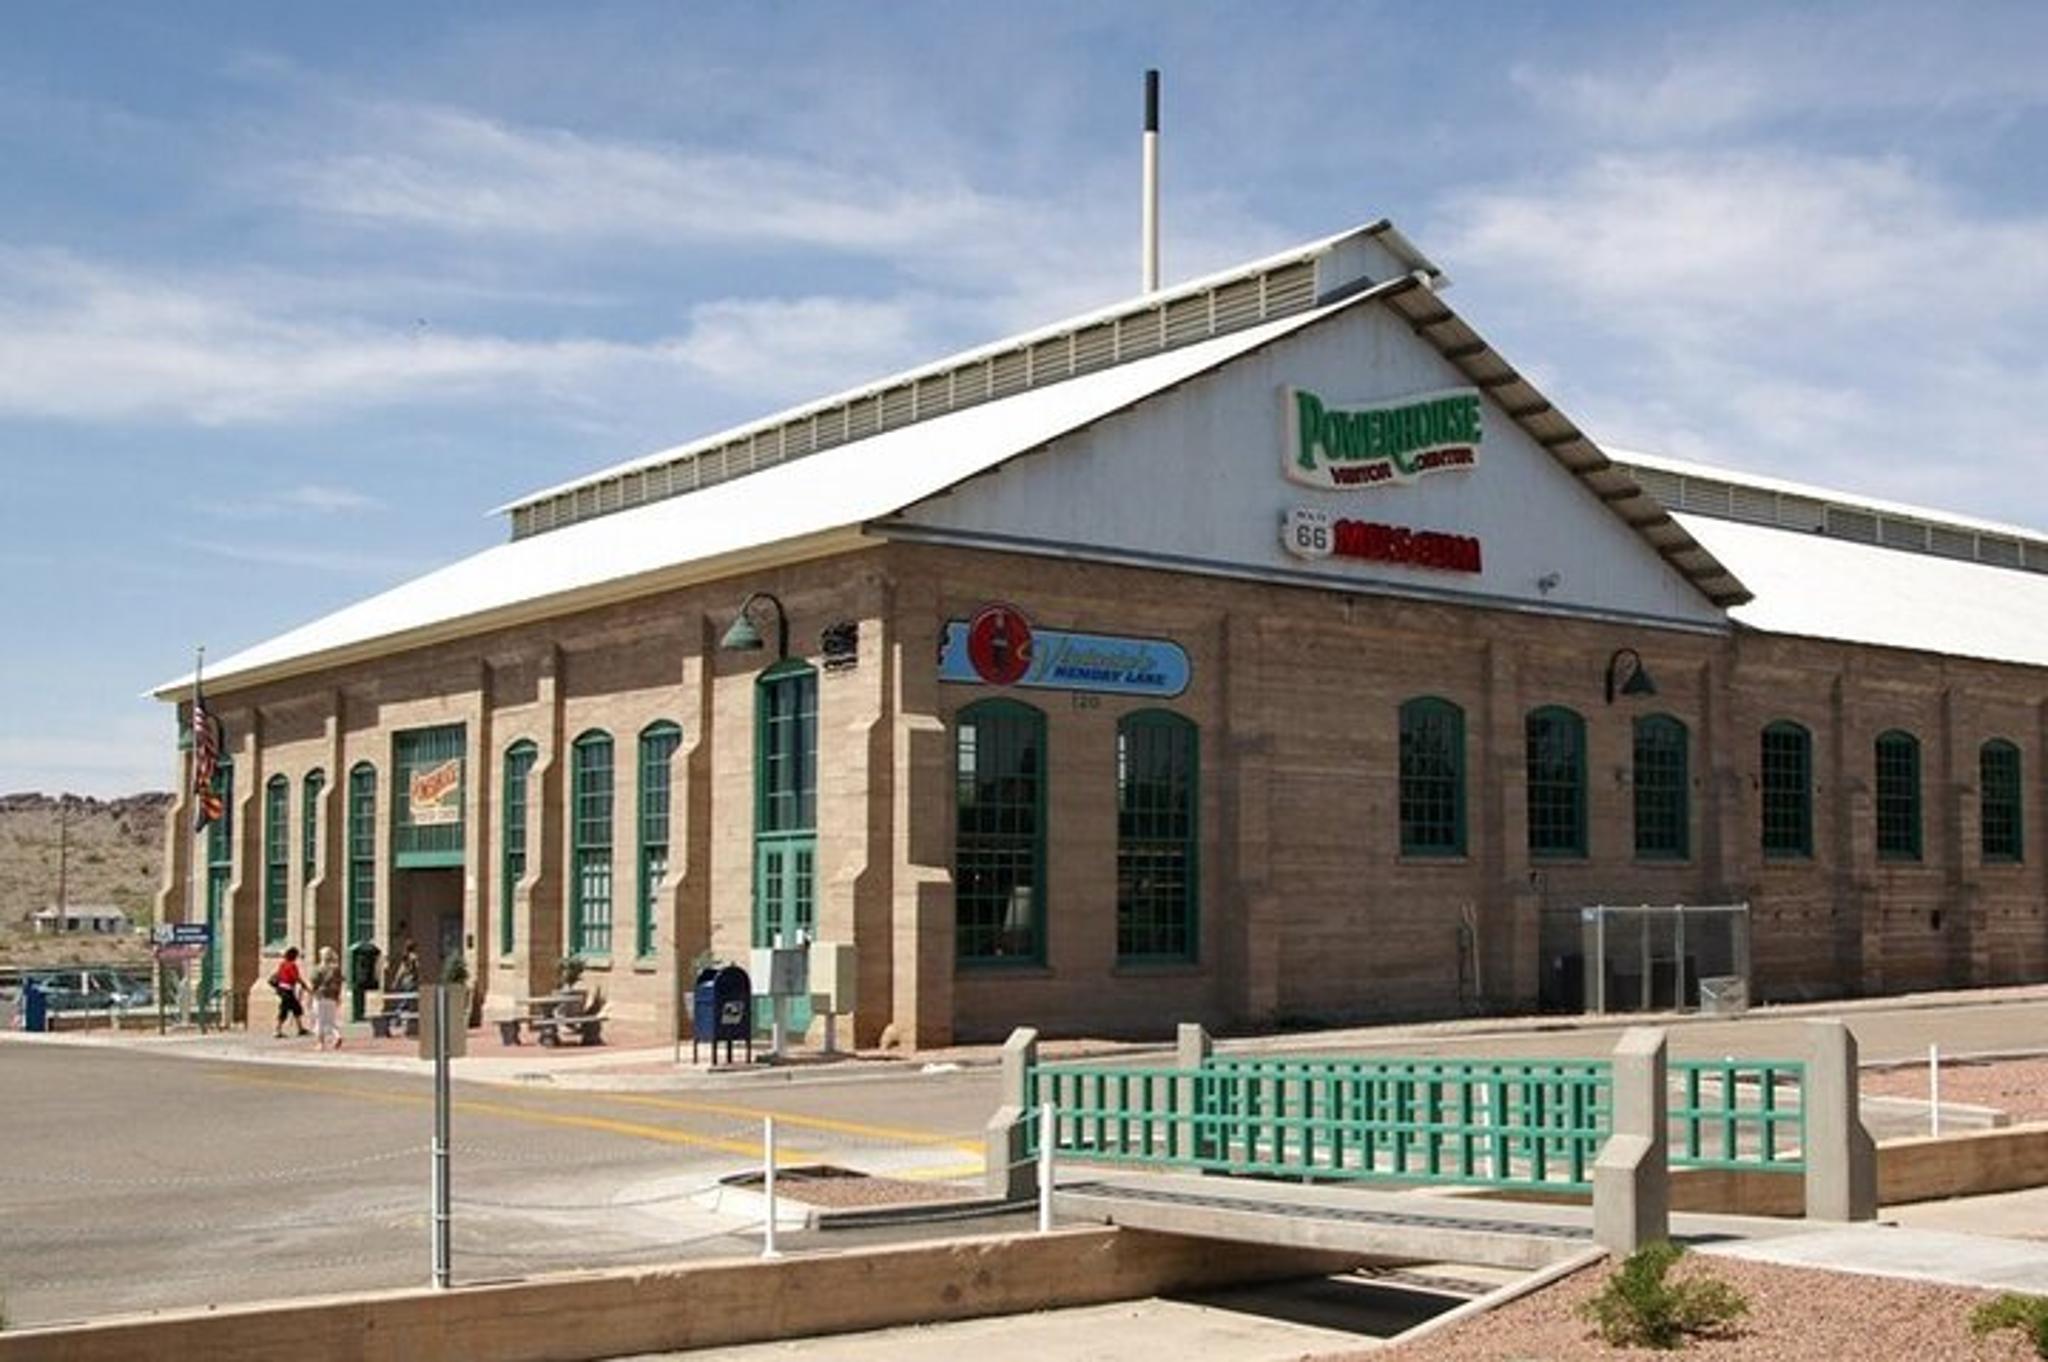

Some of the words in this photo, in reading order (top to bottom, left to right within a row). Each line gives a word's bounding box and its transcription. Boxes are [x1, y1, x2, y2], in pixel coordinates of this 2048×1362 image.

[1296, 391, 1482, 473] POWERHOUSE
[1329, 462, 1393, 485] VISITOR
[1414, 447, 1475, 471] CENTER
[1296, 525, 1327, 550] 66
[1053, 665, 1123, 682] MEMORY
[1124, 671, 1167, 686] LANE
